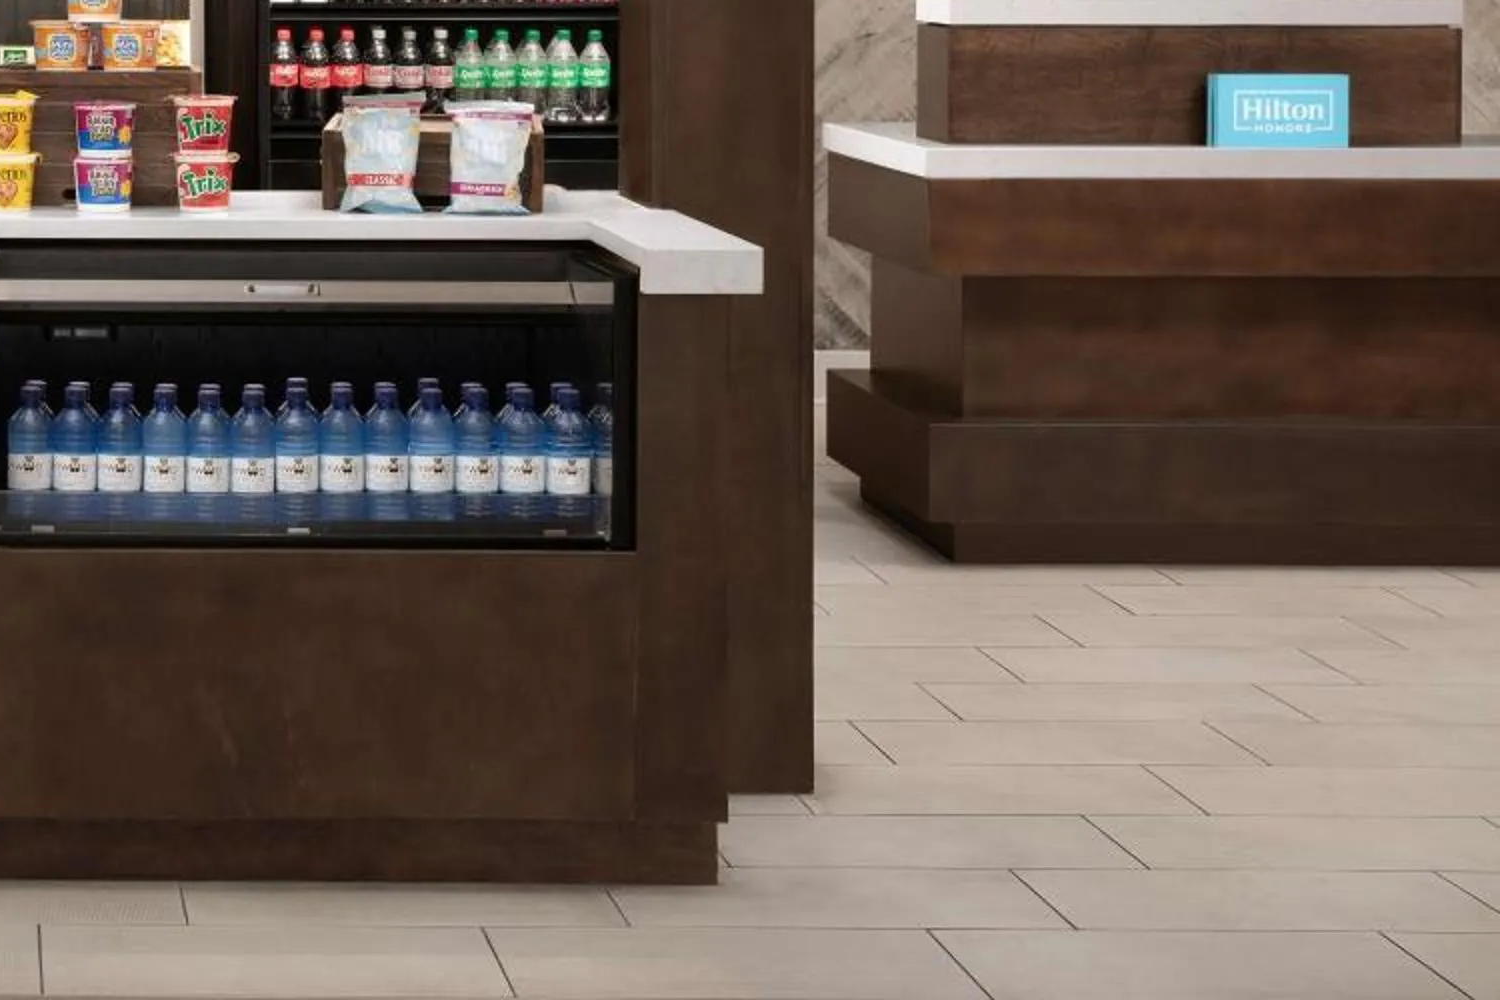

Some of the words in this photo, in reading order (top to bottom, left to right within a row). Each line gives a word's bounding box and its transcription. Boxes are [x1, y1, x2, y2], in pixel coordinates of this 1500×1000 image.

[1242, 96, 1324, 122] Hilton
[181, 112, 226, 140] Trix
[183, 168, 228, 196] Trix
